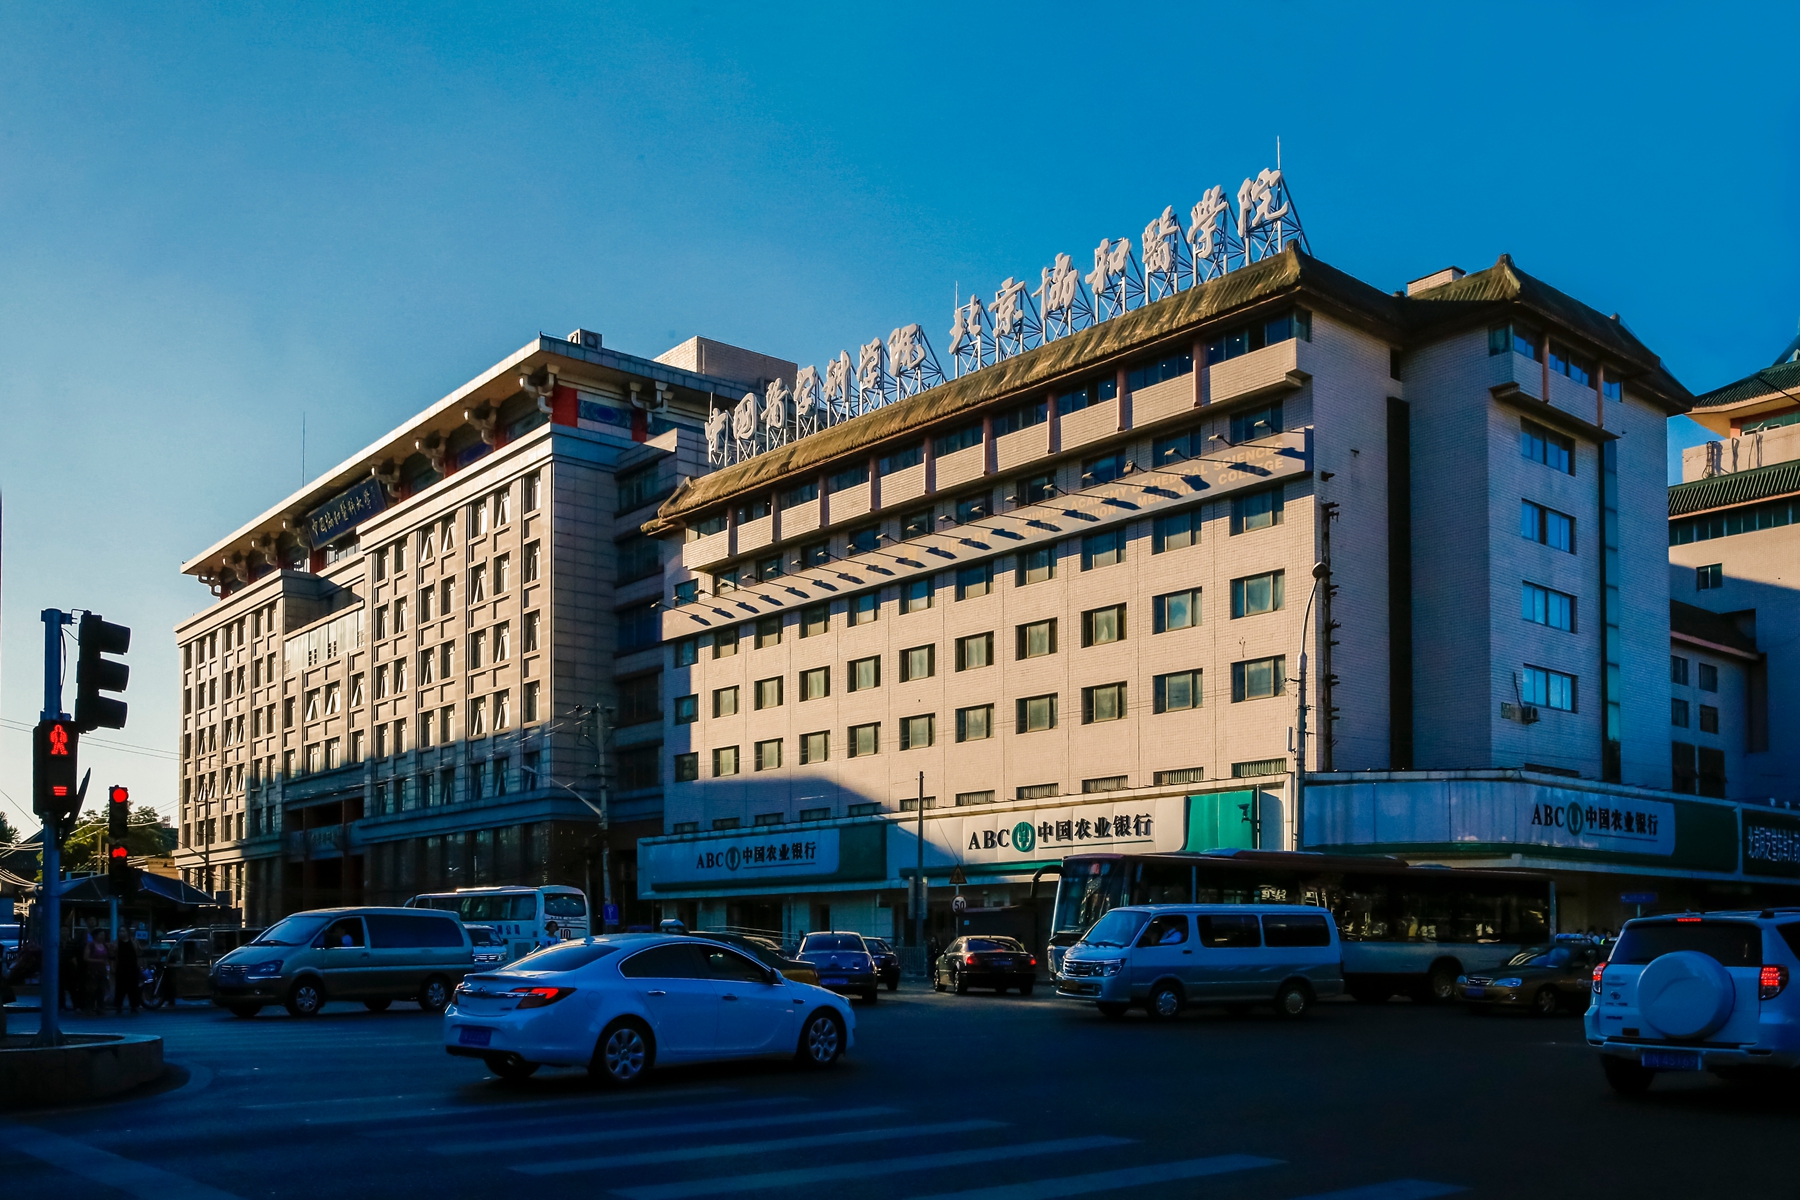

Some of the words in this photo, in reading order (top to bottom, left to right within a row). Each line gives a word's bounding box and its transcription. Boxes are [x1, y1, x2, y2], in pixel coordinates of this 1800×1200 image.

[1016, 504, 1065, 526] CHINESE
[1071, 486, 1127, 510] ACADEMY
[1131, 480, 1149, 493] OF
[1151, 464, 1208, 487] MEDICAL
[1214, 442, 1284, 471] SCIENCES
[1017, 520, 1059, 539] PEKING
[1078, 506, 1117, 523] UNION
[1137, 485, 1196, 506] MEDICAL
[1218, 457, 1284, 485] COLLEGE
[939, 529, 990, 554] LIBRARY
[968, 828, 1011, 851] ABC
[1037, 814, 1154, 844] 中国农业银行
[1531, 804, 1565, 828] ABC
[1585, 809, 1659, 837] 中国农业银行
[695, 851, 725, 870] ABC
[742, 841, 817, 865] 中国农业银行
[954, 900, 966, 911] 50
